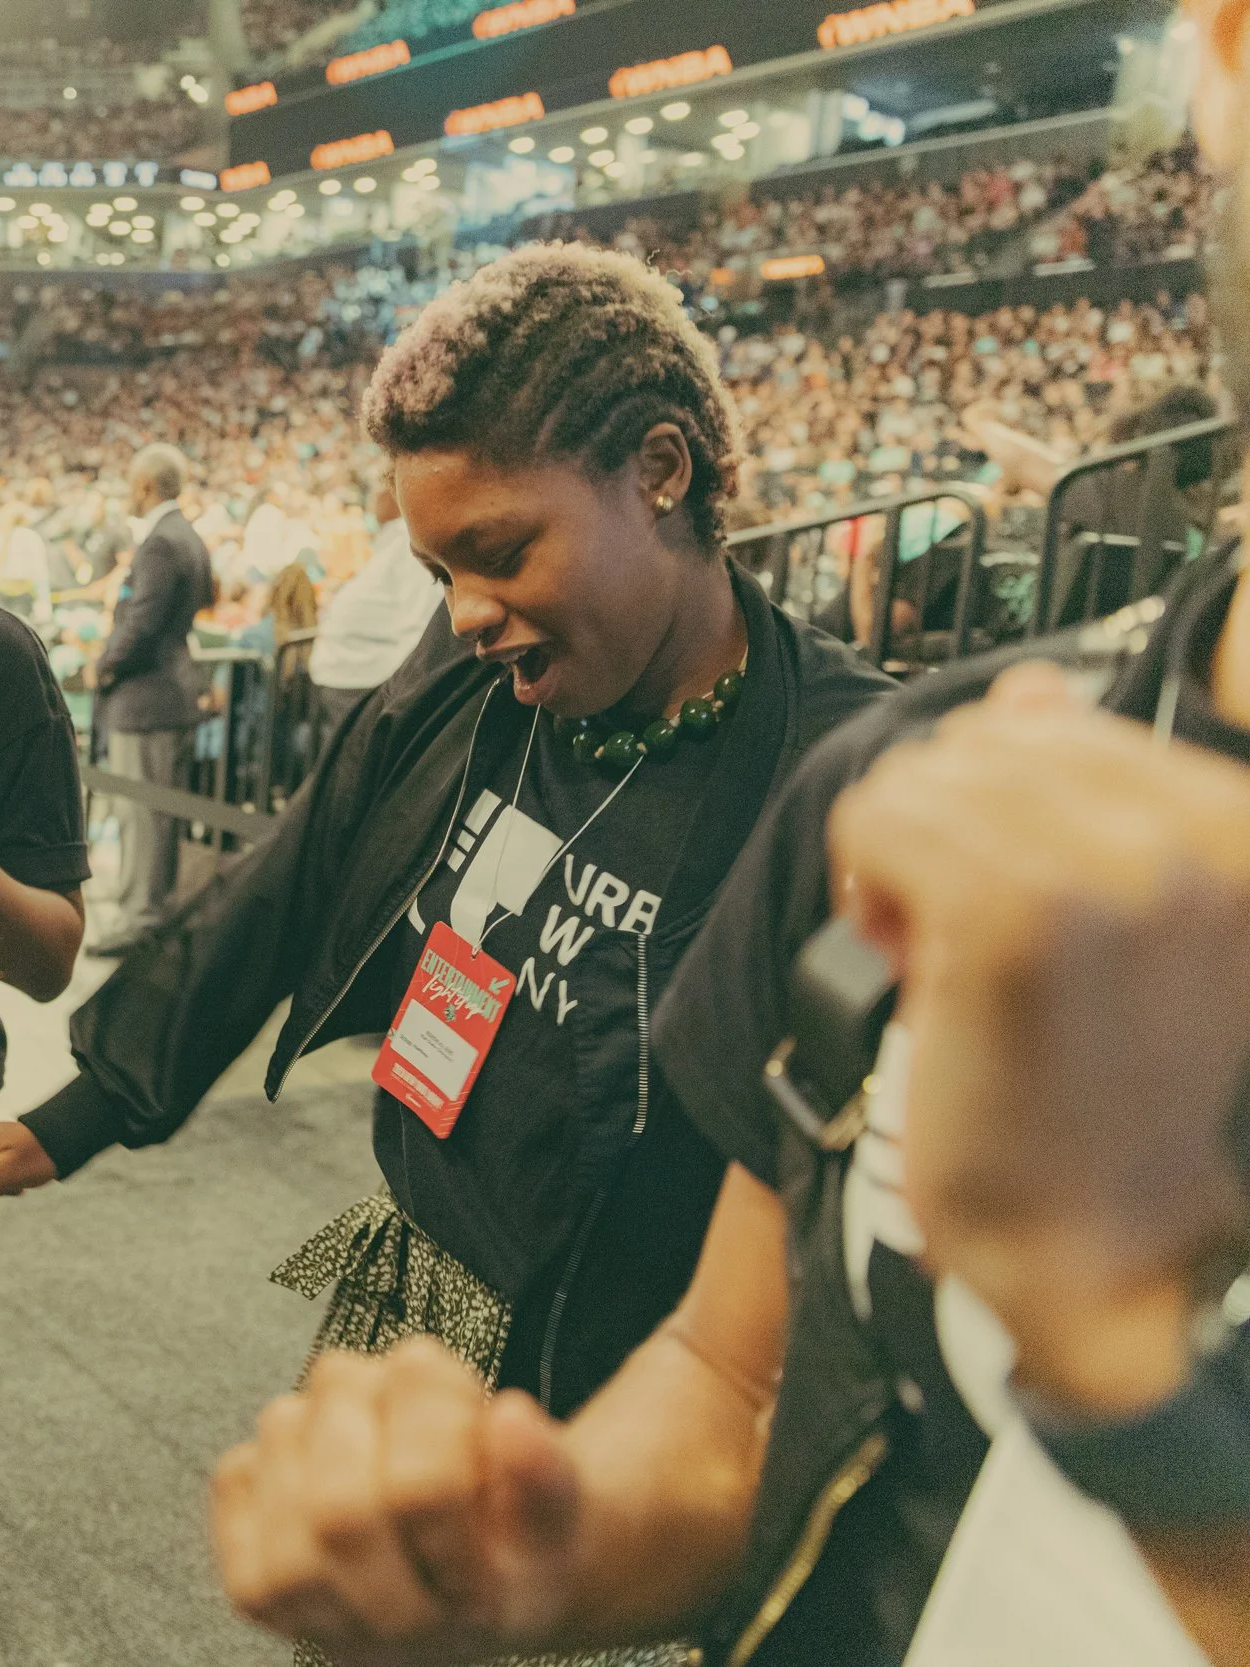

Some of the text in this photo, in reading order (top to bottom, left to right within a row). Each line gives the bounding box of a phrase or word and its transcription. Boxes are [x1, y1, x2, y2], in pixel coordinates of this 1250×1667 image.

[564, 853, 662, 935] URB
[539, 904, 595, 967] W
[421, 948, 502, 1023] ENTERTAINMENT
